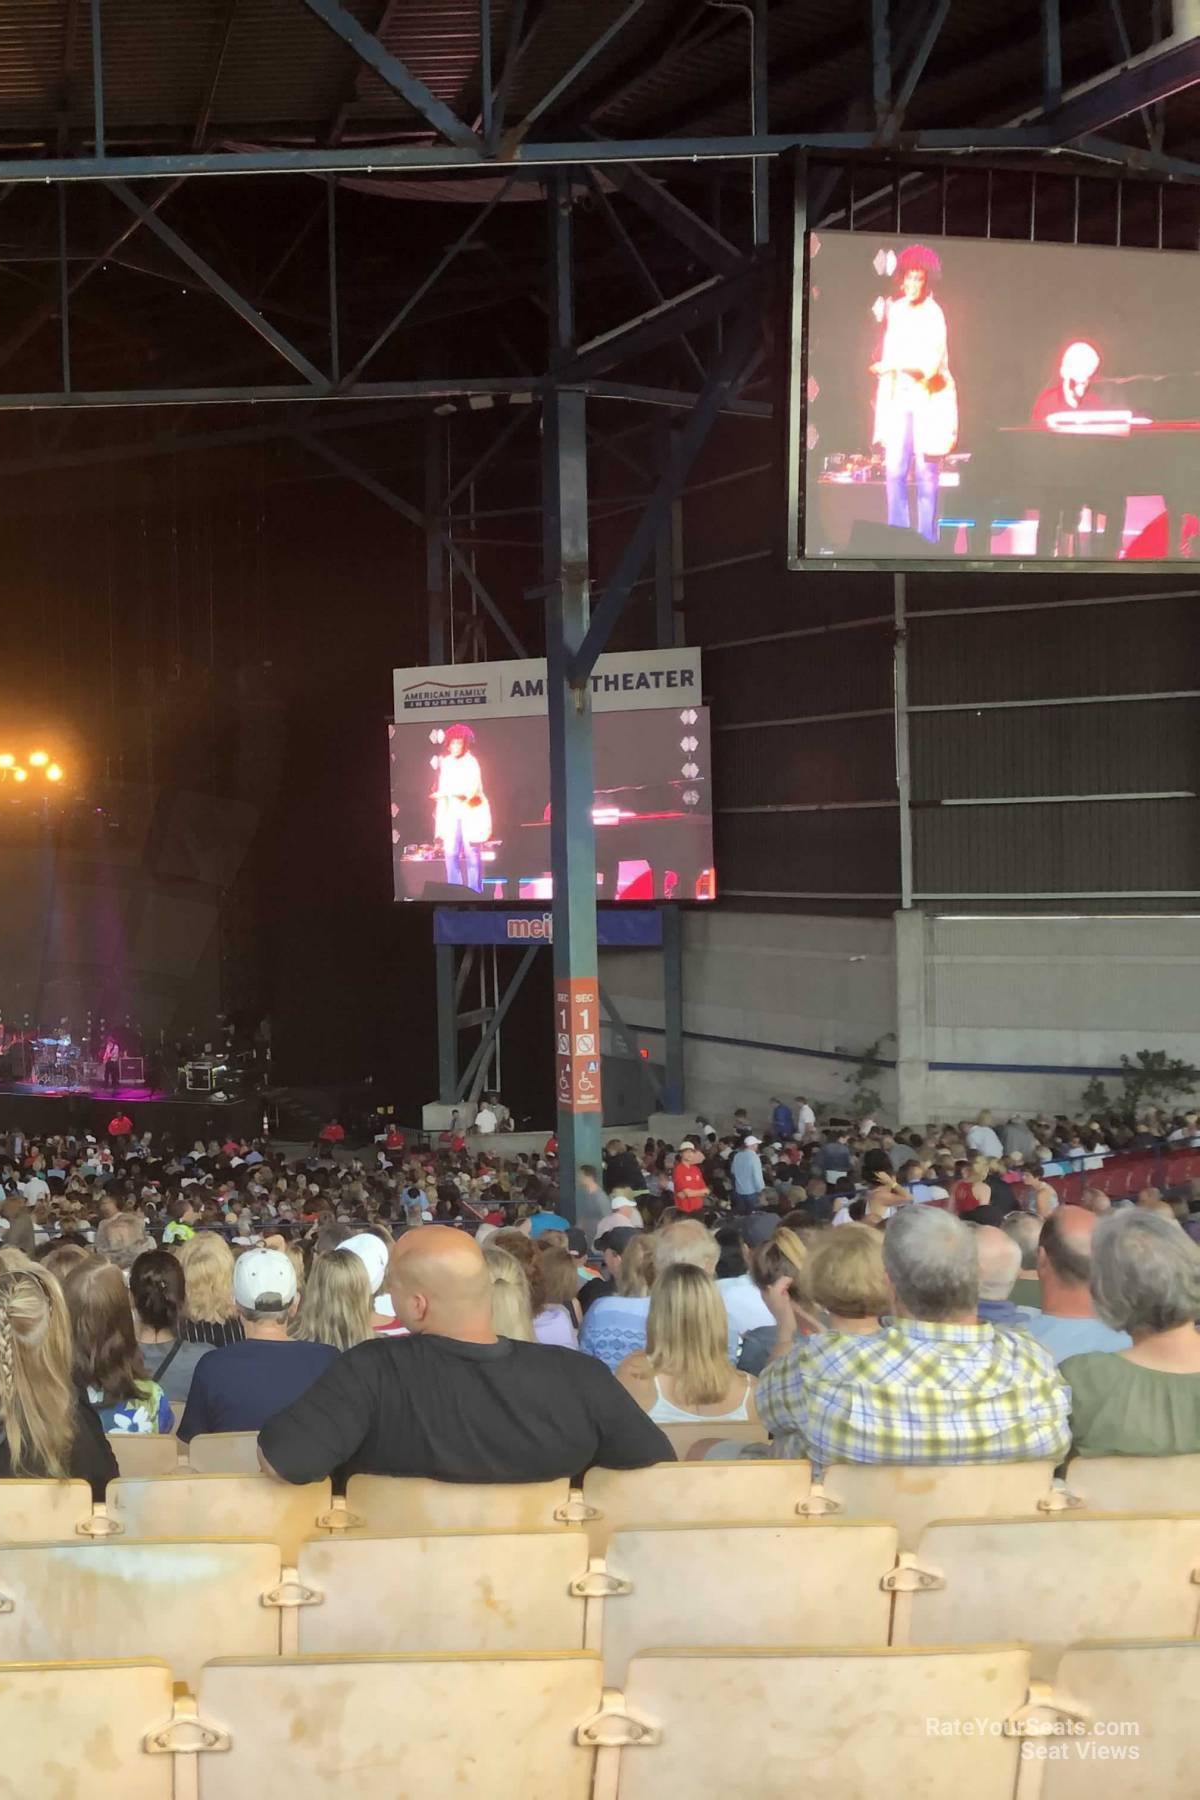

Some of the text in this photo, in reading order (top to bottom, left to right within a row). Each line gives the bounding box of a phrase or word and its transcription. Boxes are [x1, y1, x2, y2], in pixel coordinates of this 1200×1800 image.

[404, 669, 694, 701] AMERICAN FAMILY AMTHEATER
[409, 698, 483, 708] INSURANCE
[560, 1009, 567, 1030] 1
[579, 1009, 589, 1030] 1
